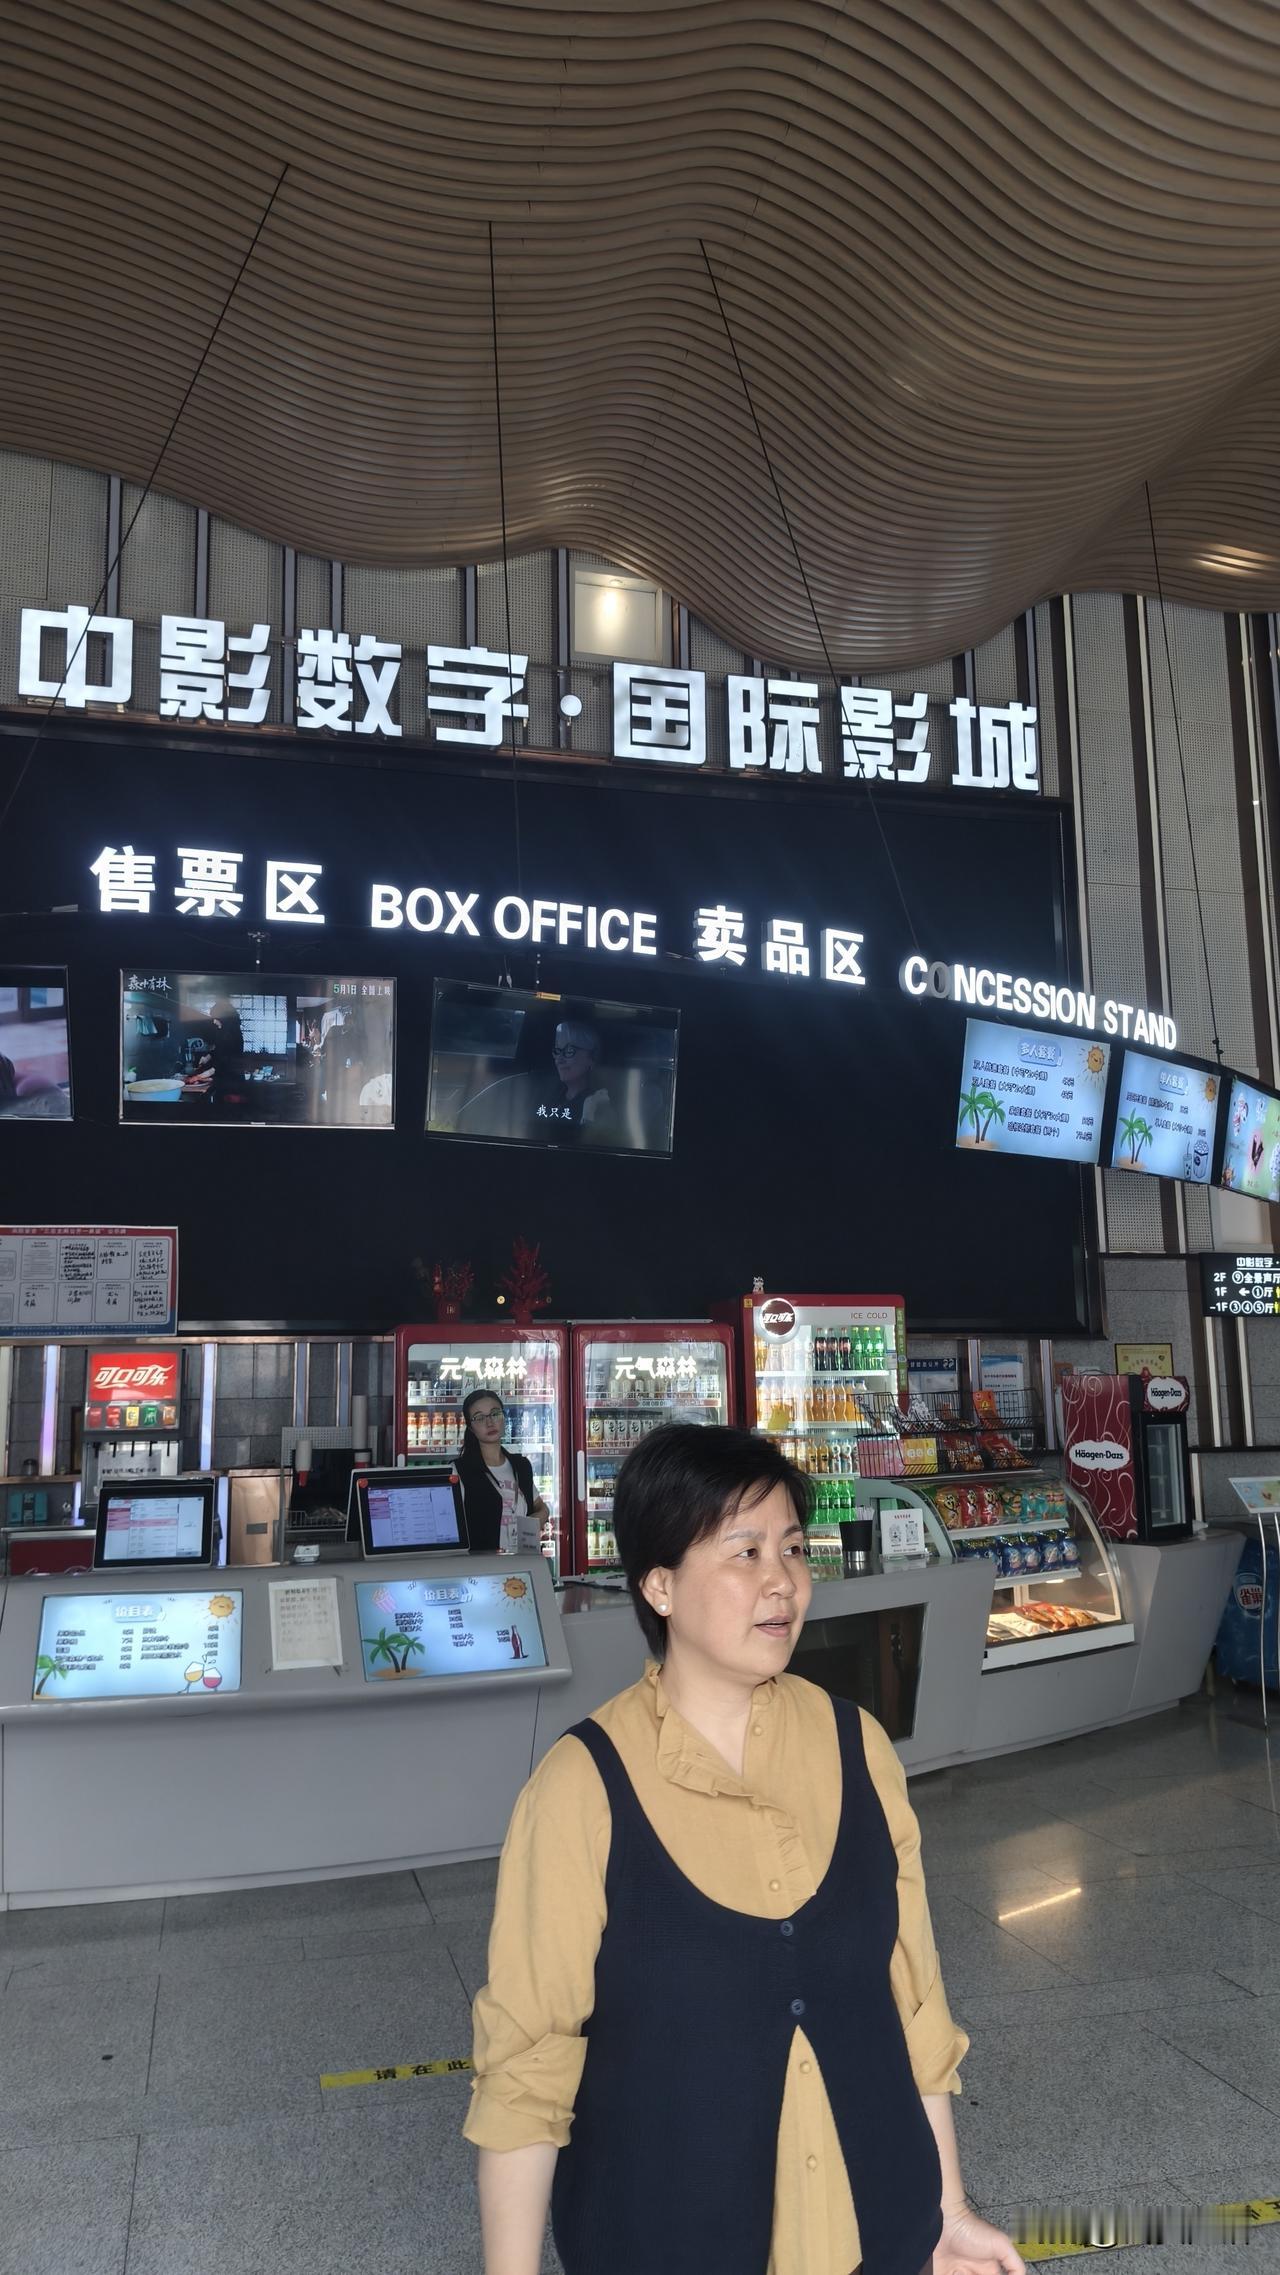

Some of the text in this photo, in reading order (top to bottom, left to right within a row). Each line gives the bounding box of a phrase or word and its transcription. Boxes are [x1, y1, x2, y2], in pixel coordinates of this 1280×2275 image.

[18, 605, 1039, 792] 中影数字·国际影城
[90, 845, 1176, 1051] 售票区 BOX OFFICE 卖品区 CONCESSION STAND
[536, 1104, 573, 1120] 我只是
[1213, 1272, 1226, 1282] 2F
[1215, 1287, 1227, 1296] 1F
[1210, 1302, 1228, 1312] -1F
[94, 1365, 174, 1389] 可口可乐
[439, 1356, 528, 1380] 元气森林
[615, 1356, 698, 1380] 元气森林
[1075, 1449, 1124, 1461] Häagen-Dazs
